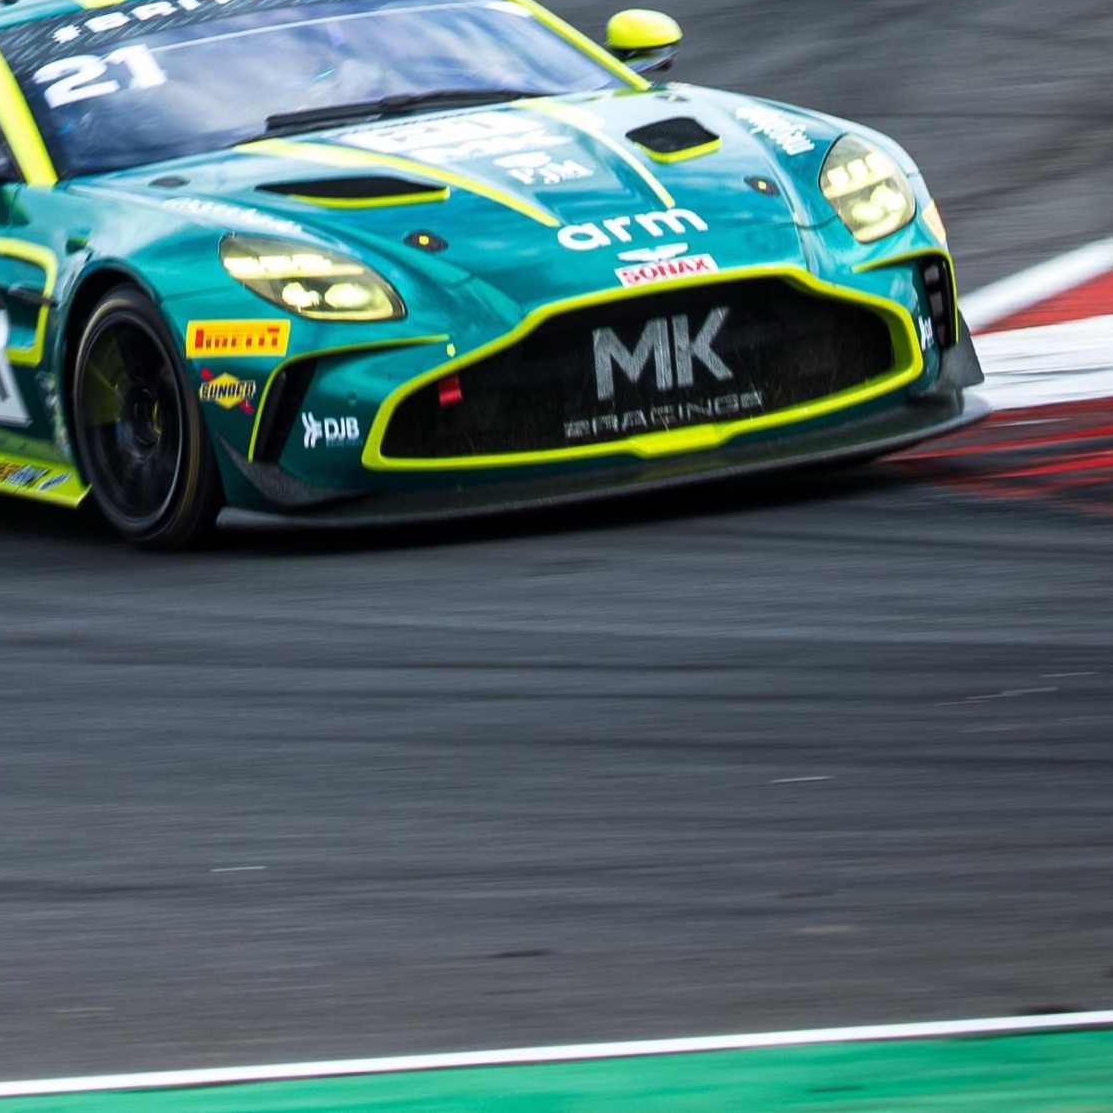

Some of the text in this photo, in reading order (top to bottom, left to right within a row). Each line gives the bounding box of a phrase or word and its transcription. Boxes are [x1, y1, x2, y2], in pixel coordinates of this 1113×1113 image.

[32, 44, 167, 109] 21
[557, 208, 709, 251] arm
[622, 257, 709, 284] SONAX
[592, 306, 734, 401] MK
[324, 416, 360, 440] DJB
